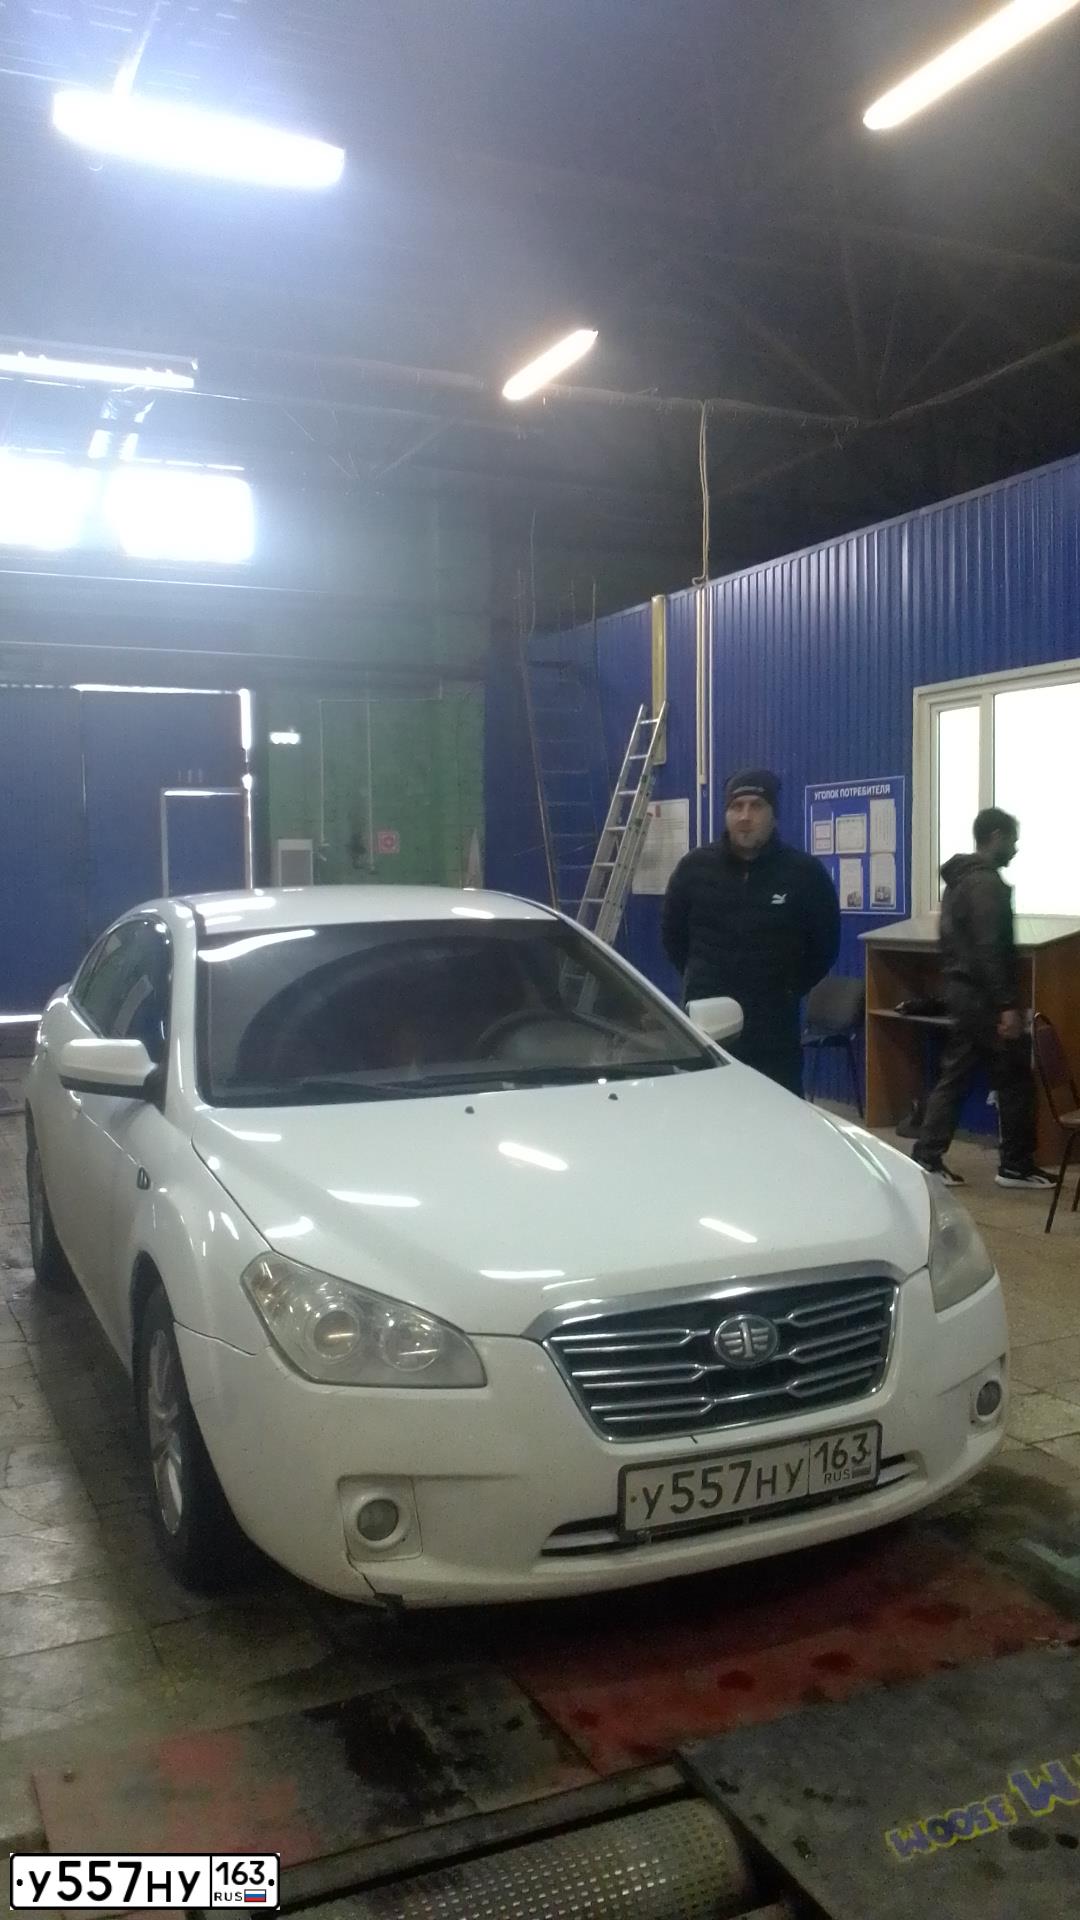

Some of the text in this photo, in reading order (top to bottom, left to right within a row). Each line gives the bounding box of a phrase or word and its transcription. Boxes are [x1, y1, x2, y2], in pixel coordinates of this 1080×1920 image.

[814, 784, 891, 801] УГОЛОК ПОТРЕБИТЕЛЯ
[824, 1469, 850, 1484] RUS
